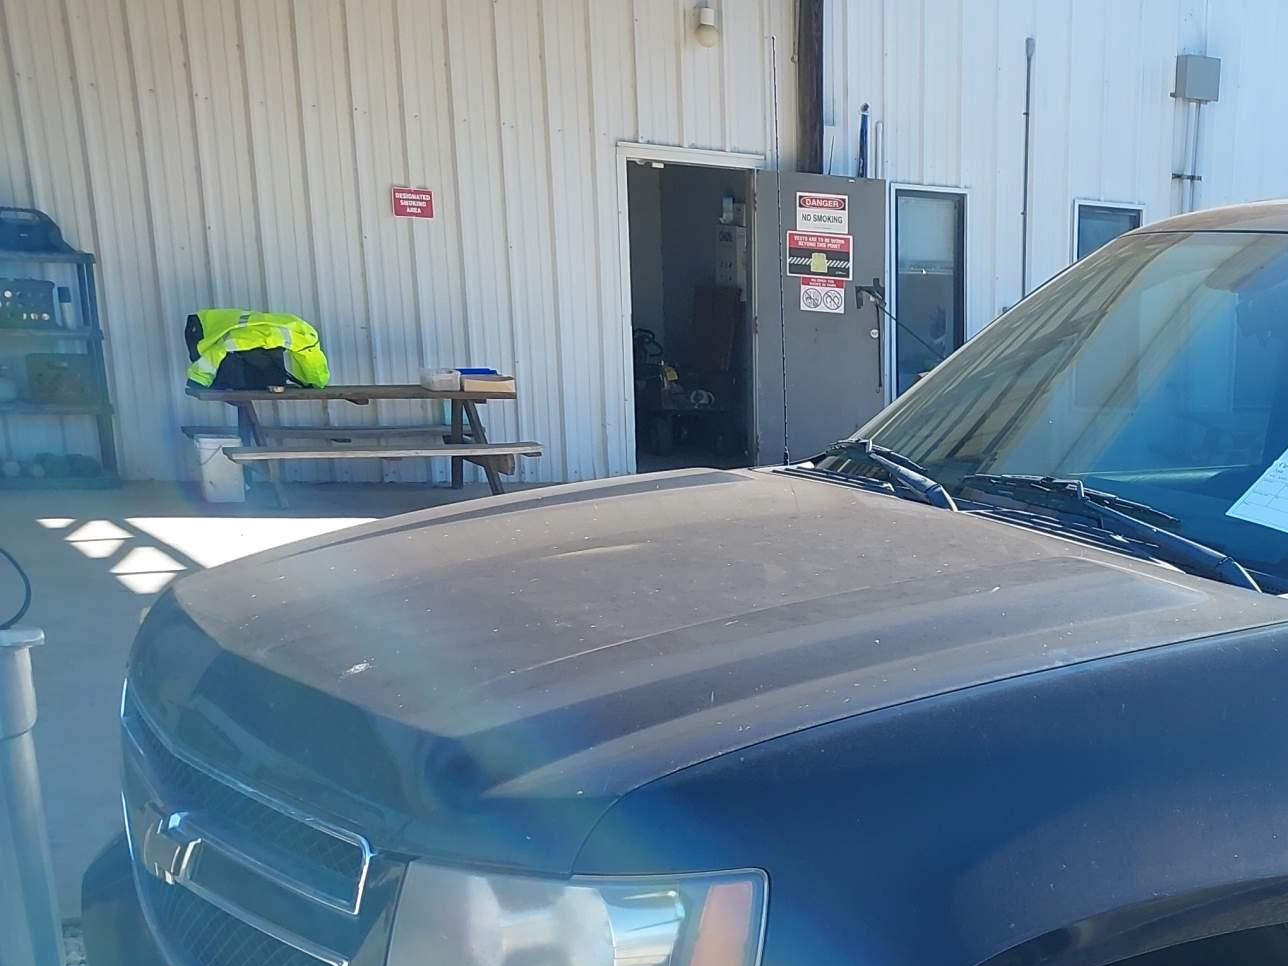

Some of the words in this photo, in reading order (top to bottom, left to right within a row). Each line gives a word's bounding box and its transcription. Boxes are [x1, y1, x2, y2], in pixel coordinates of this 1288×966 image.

[395, 192, 431, 201] DESIGNATED
[805, 198, 839, 208] DANGER
[801, 213, 812, 221] NO
[812, 214, 843, 224] SMOKING
